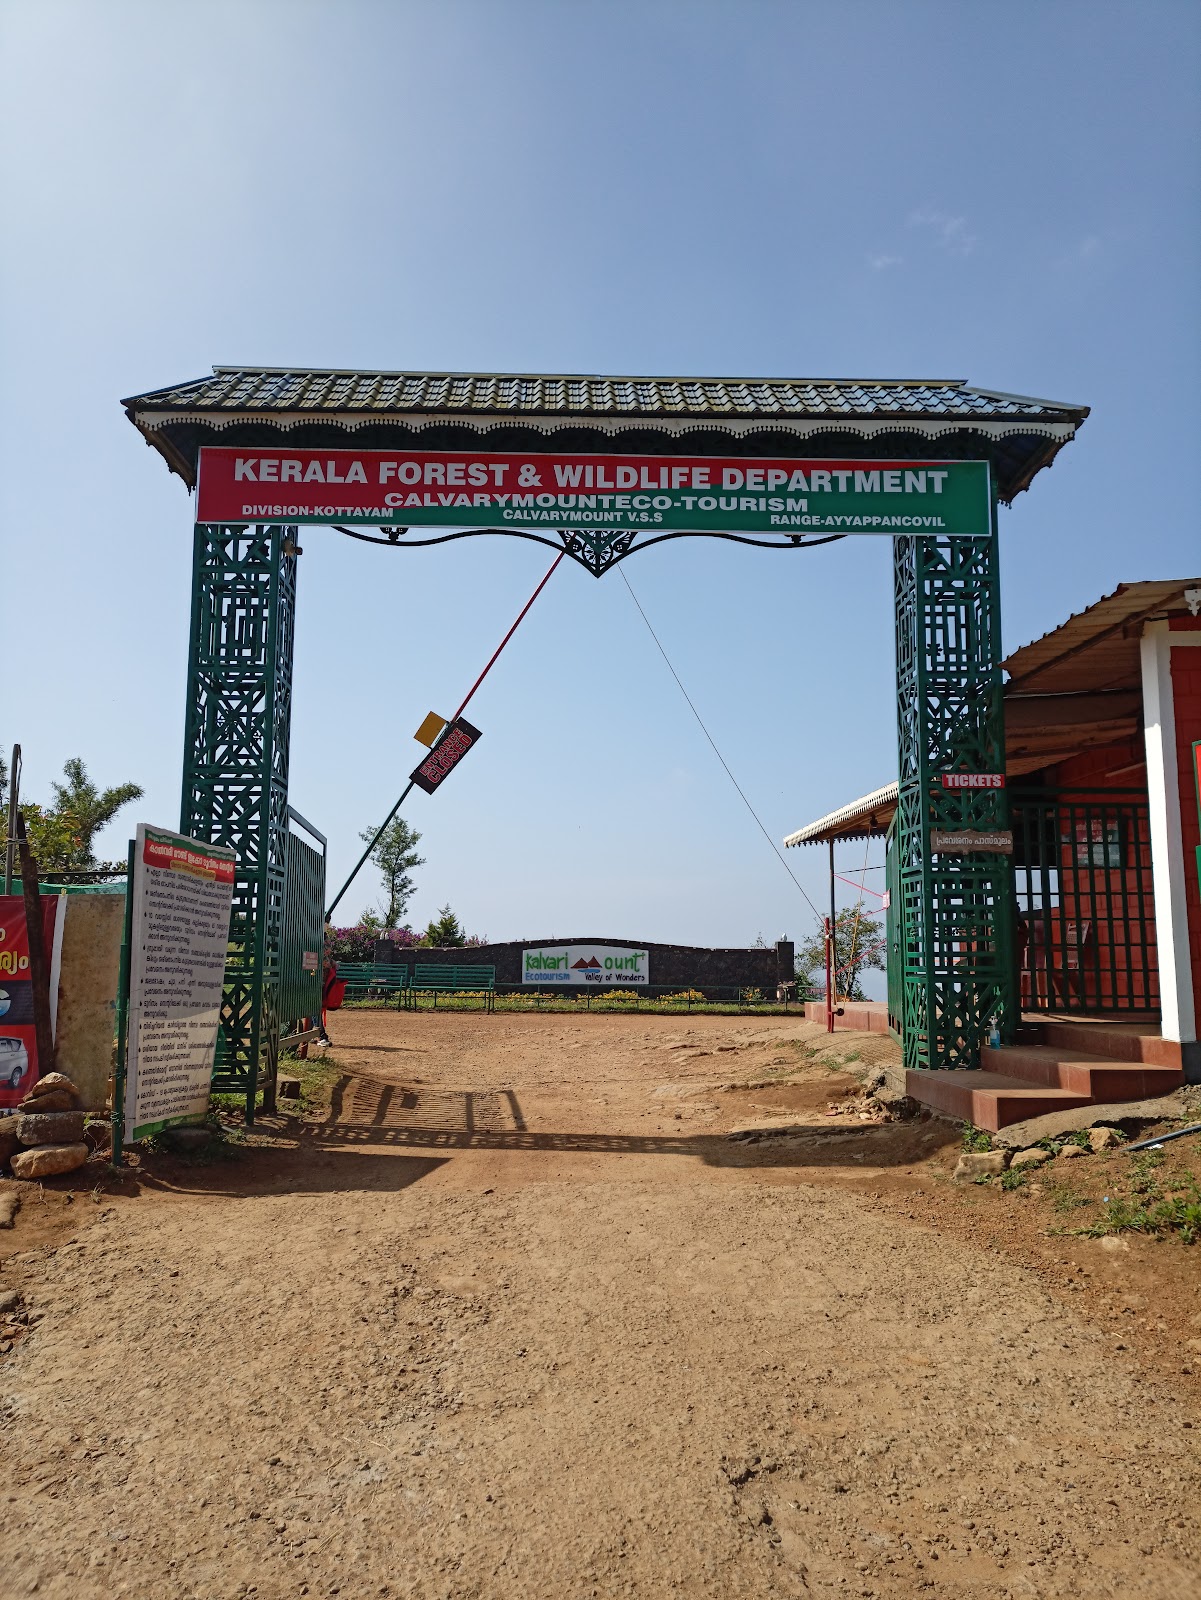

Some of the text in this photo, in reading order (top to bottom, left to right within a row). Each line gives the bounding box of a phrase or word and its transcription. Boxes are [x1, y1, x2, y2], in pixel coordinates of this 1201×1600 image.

[234, 458, 949, 494] KERALA FOREST & WILDLIFE DEPARTMENT
[242, 505, 394, 518] DIVISION-KOTTAYAM
[503, 509, 663, 523] CALVARYMOUNT V.S.S
[770, 514, 946, 527] RANGE-AYYAPPANCOVIL
[419, 728, 463, 776] ENTRANCE
[427, 734, 472, 783] CLOSED
[946, 774, 1002, 787] TICKETS
[585, 972, 604, 983] Valley
[605, 973, 613, 982] of
[616, 973, 646, 982] Wonders
